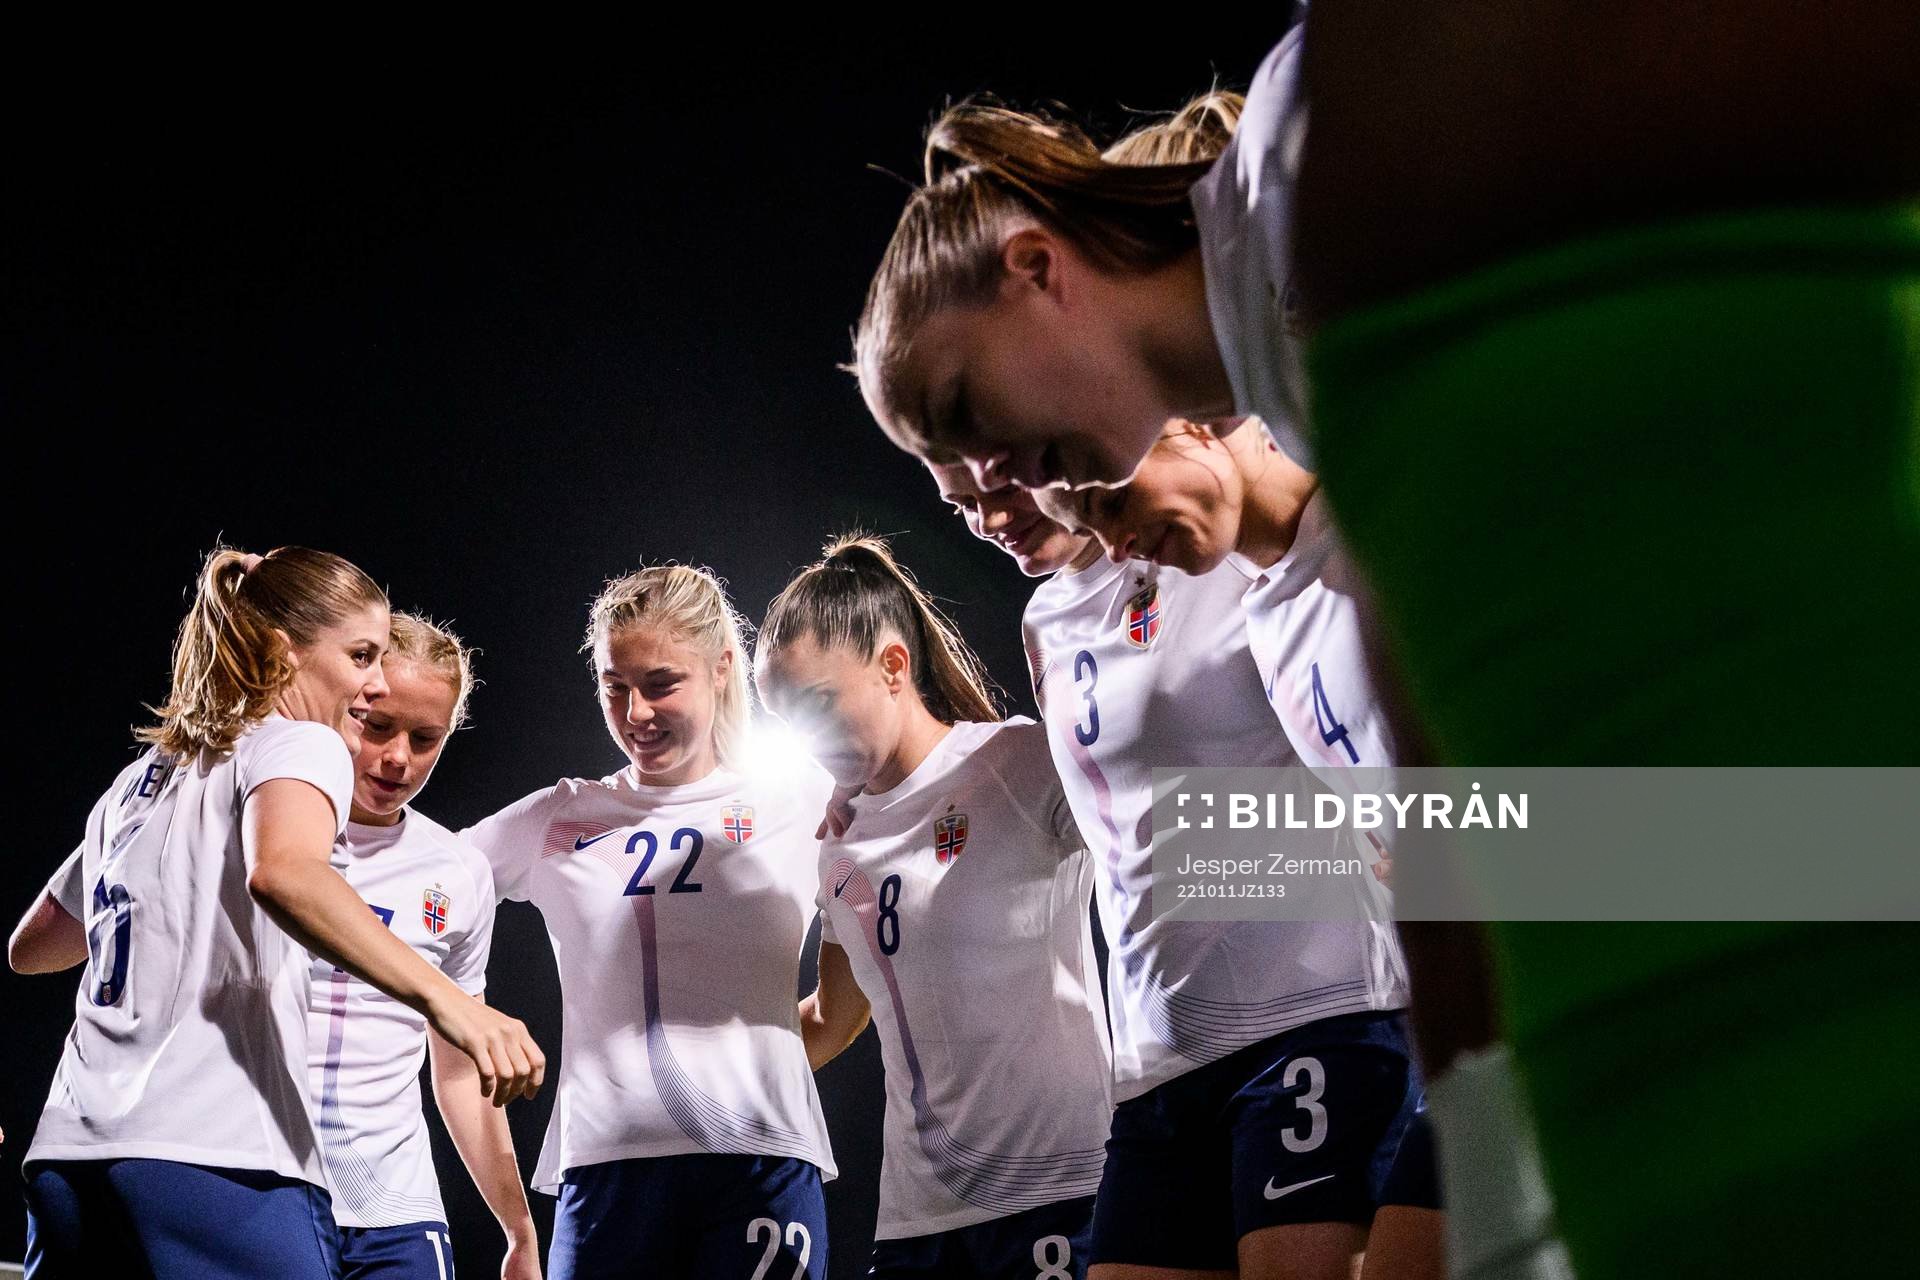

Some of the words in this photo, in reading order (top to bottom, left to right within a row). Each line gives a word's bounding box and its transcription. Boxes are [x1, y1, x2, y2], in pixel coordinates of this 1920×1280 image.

[1074, 650, 1100, 746] 3
[1312, 661, 1360, 765] 4
[623, 827, 704, 896] 22
[877, 874, 901, 956] 8
[1280, 1056, 1328, 1153] 3
[746, 1217, 811, 1280] 22
[1032, 1234, 1073, 1280] 8
